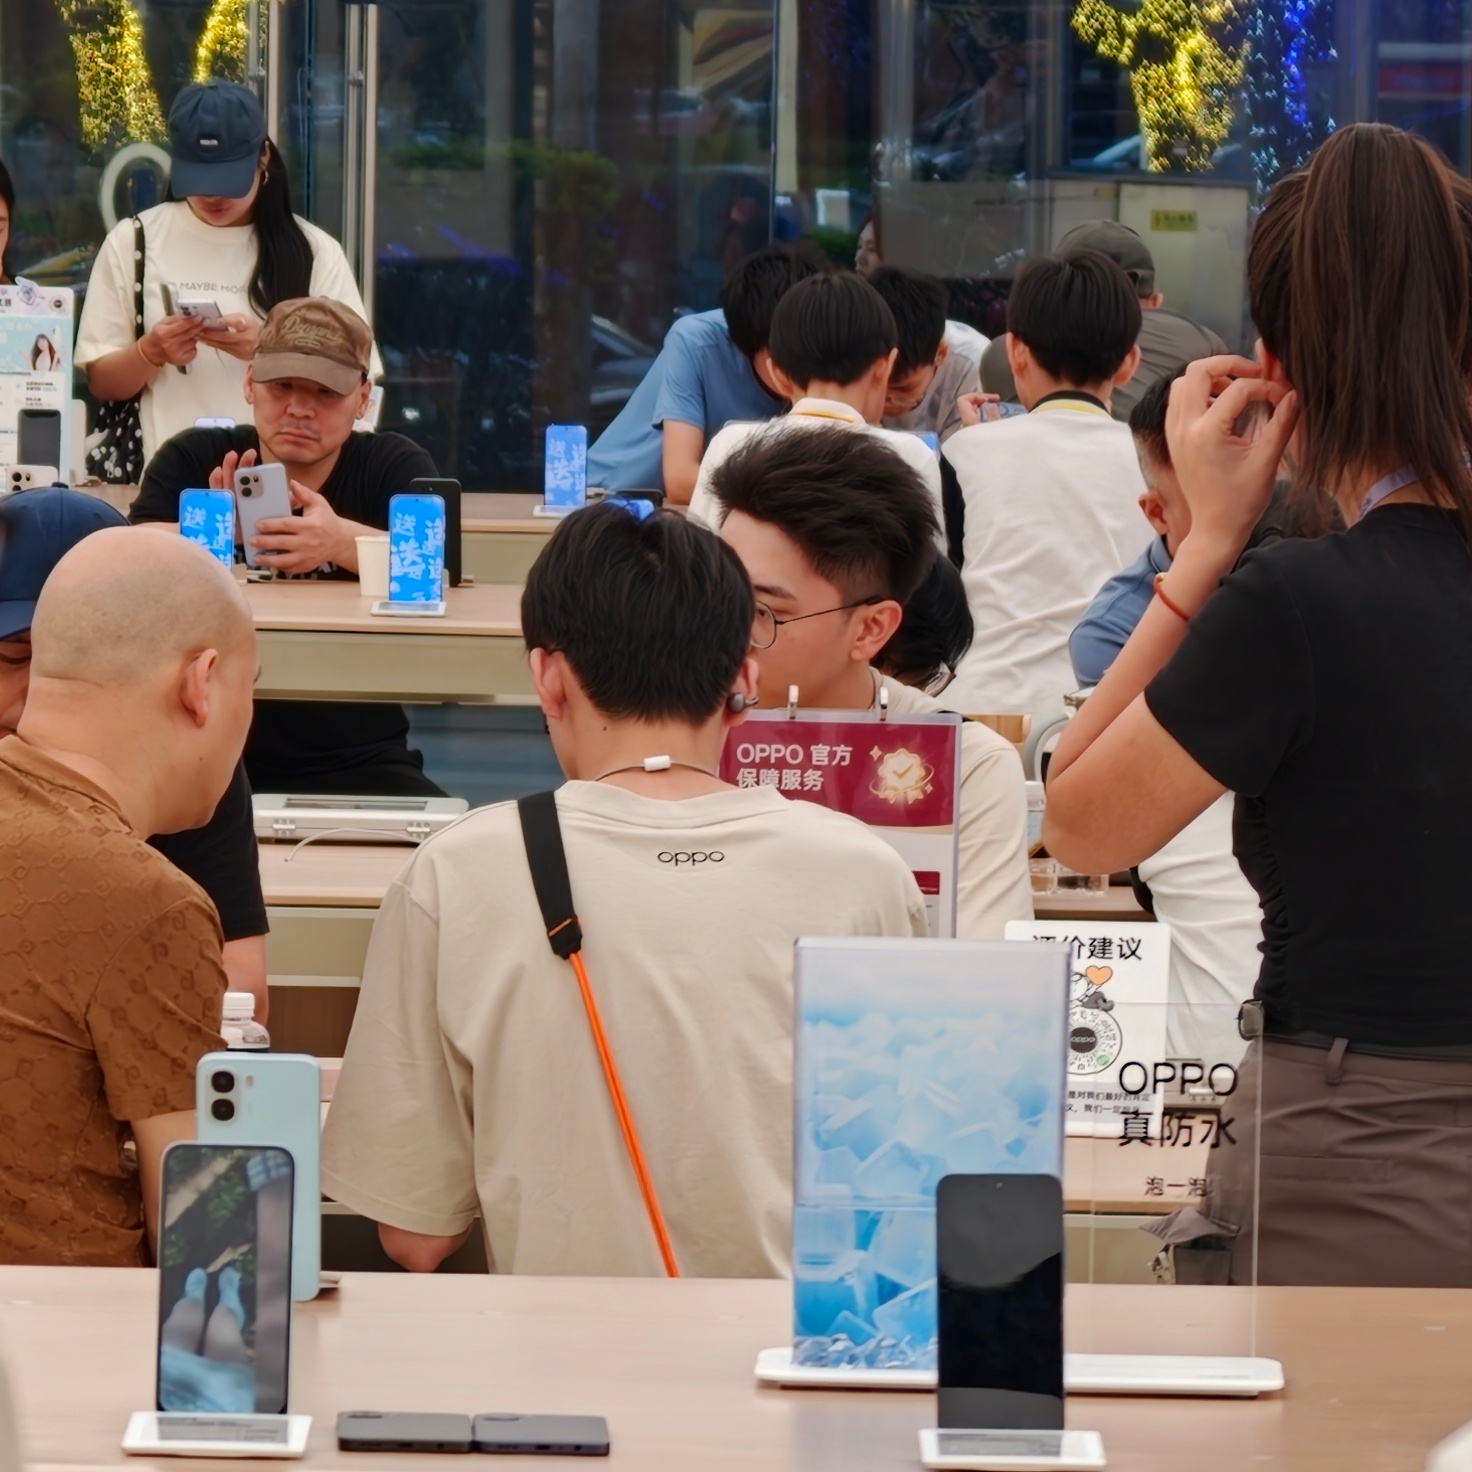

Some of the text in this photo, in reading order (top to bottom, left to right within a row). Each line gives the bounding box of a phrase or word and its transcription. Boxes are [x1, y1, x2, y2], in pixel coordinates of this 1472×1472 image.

[736, 743, 853, 766] OPPO 官方
[736, 768, 825, 792] 保障服务
[657, 850, 725, 866] oppo
[1119, 1061, 1239, 1097] OPPO
[1119, 1111, 1239, 1149] 真防水
